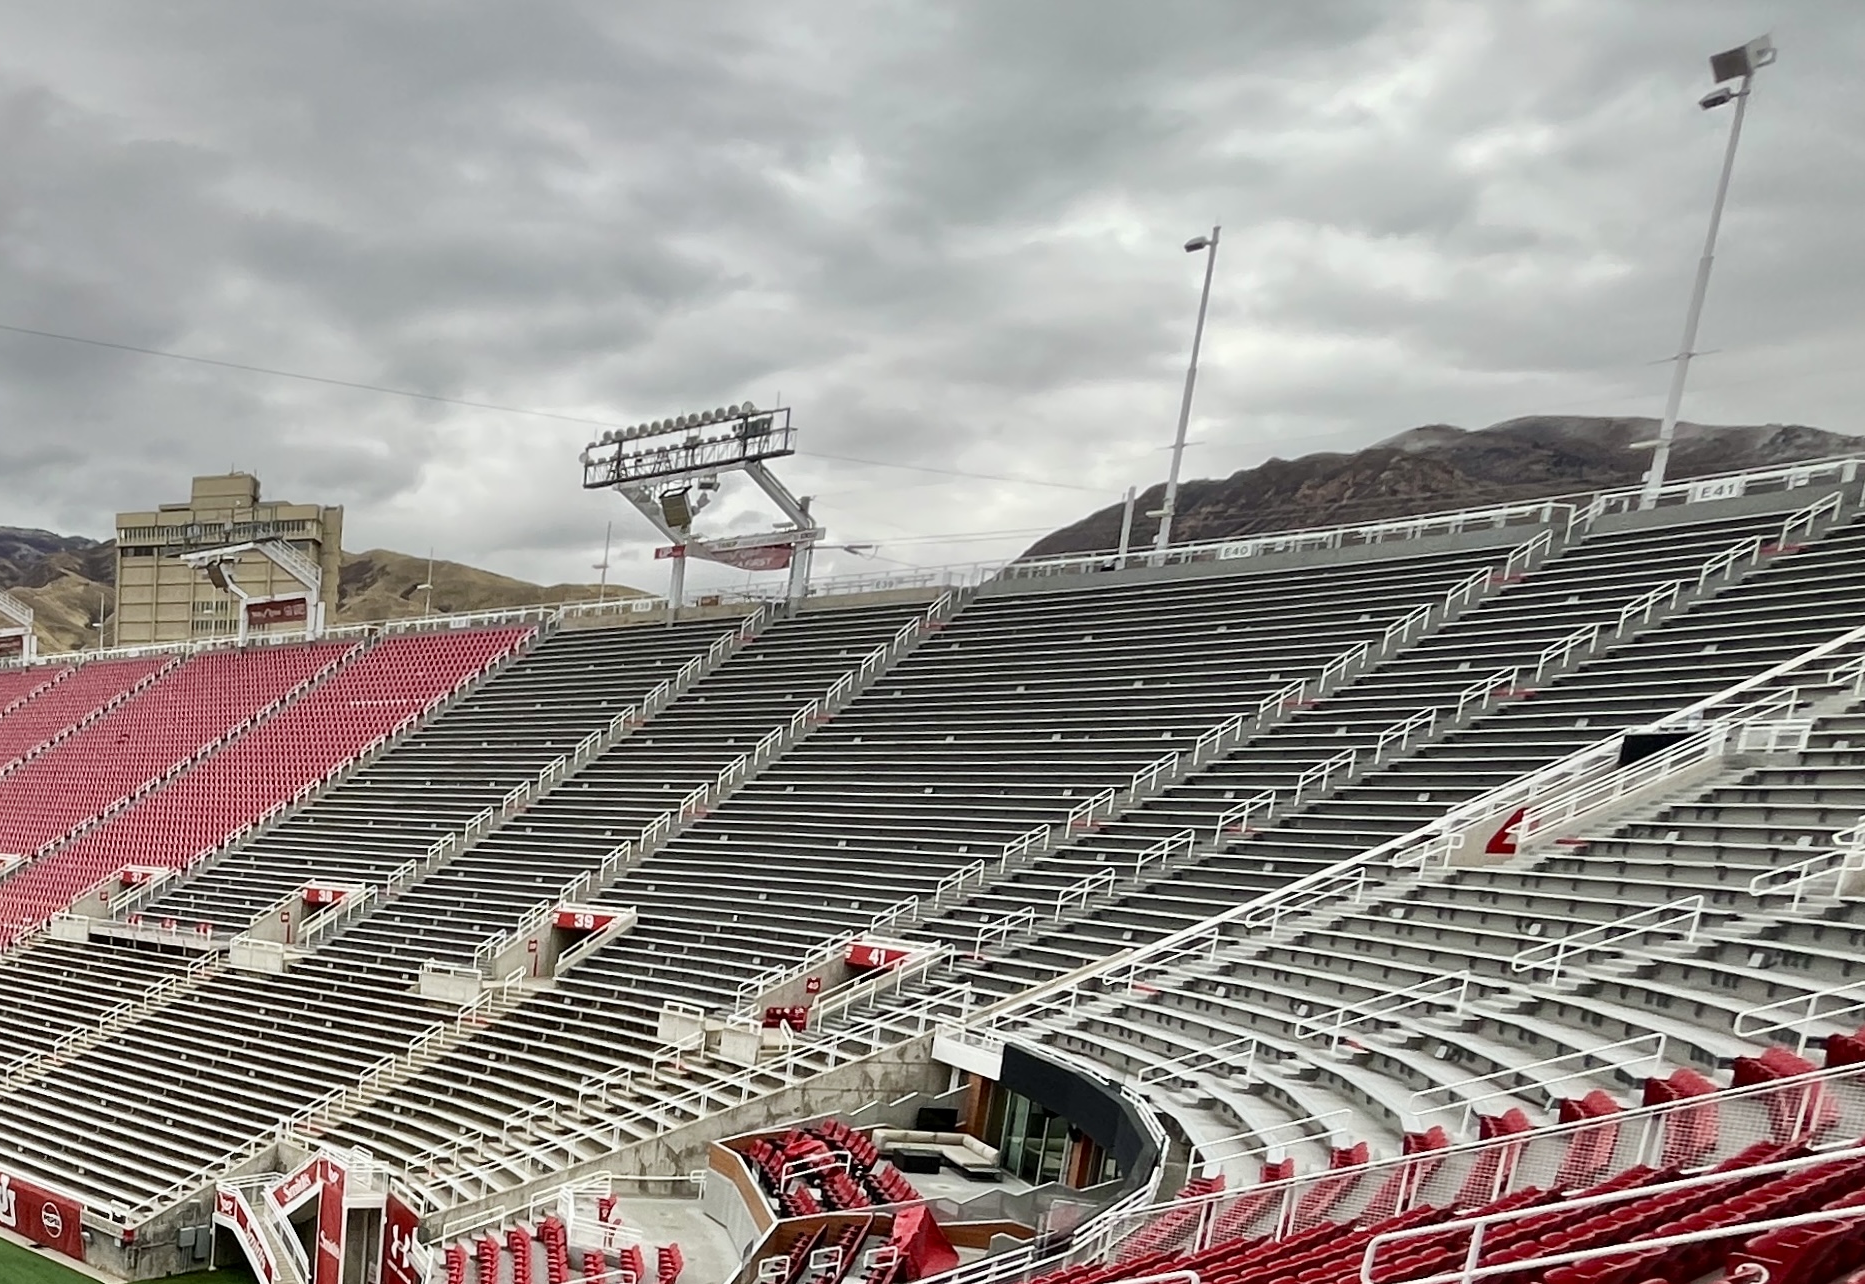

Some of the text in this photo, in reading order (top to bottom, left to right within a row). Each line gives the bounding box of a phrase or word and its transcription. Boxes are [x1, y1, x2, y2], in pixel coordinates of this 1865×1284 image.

[1701, 484, 1735, 498] E41
[574, 913, 595, 930] 39
[868, 948, 887, 967] 41
